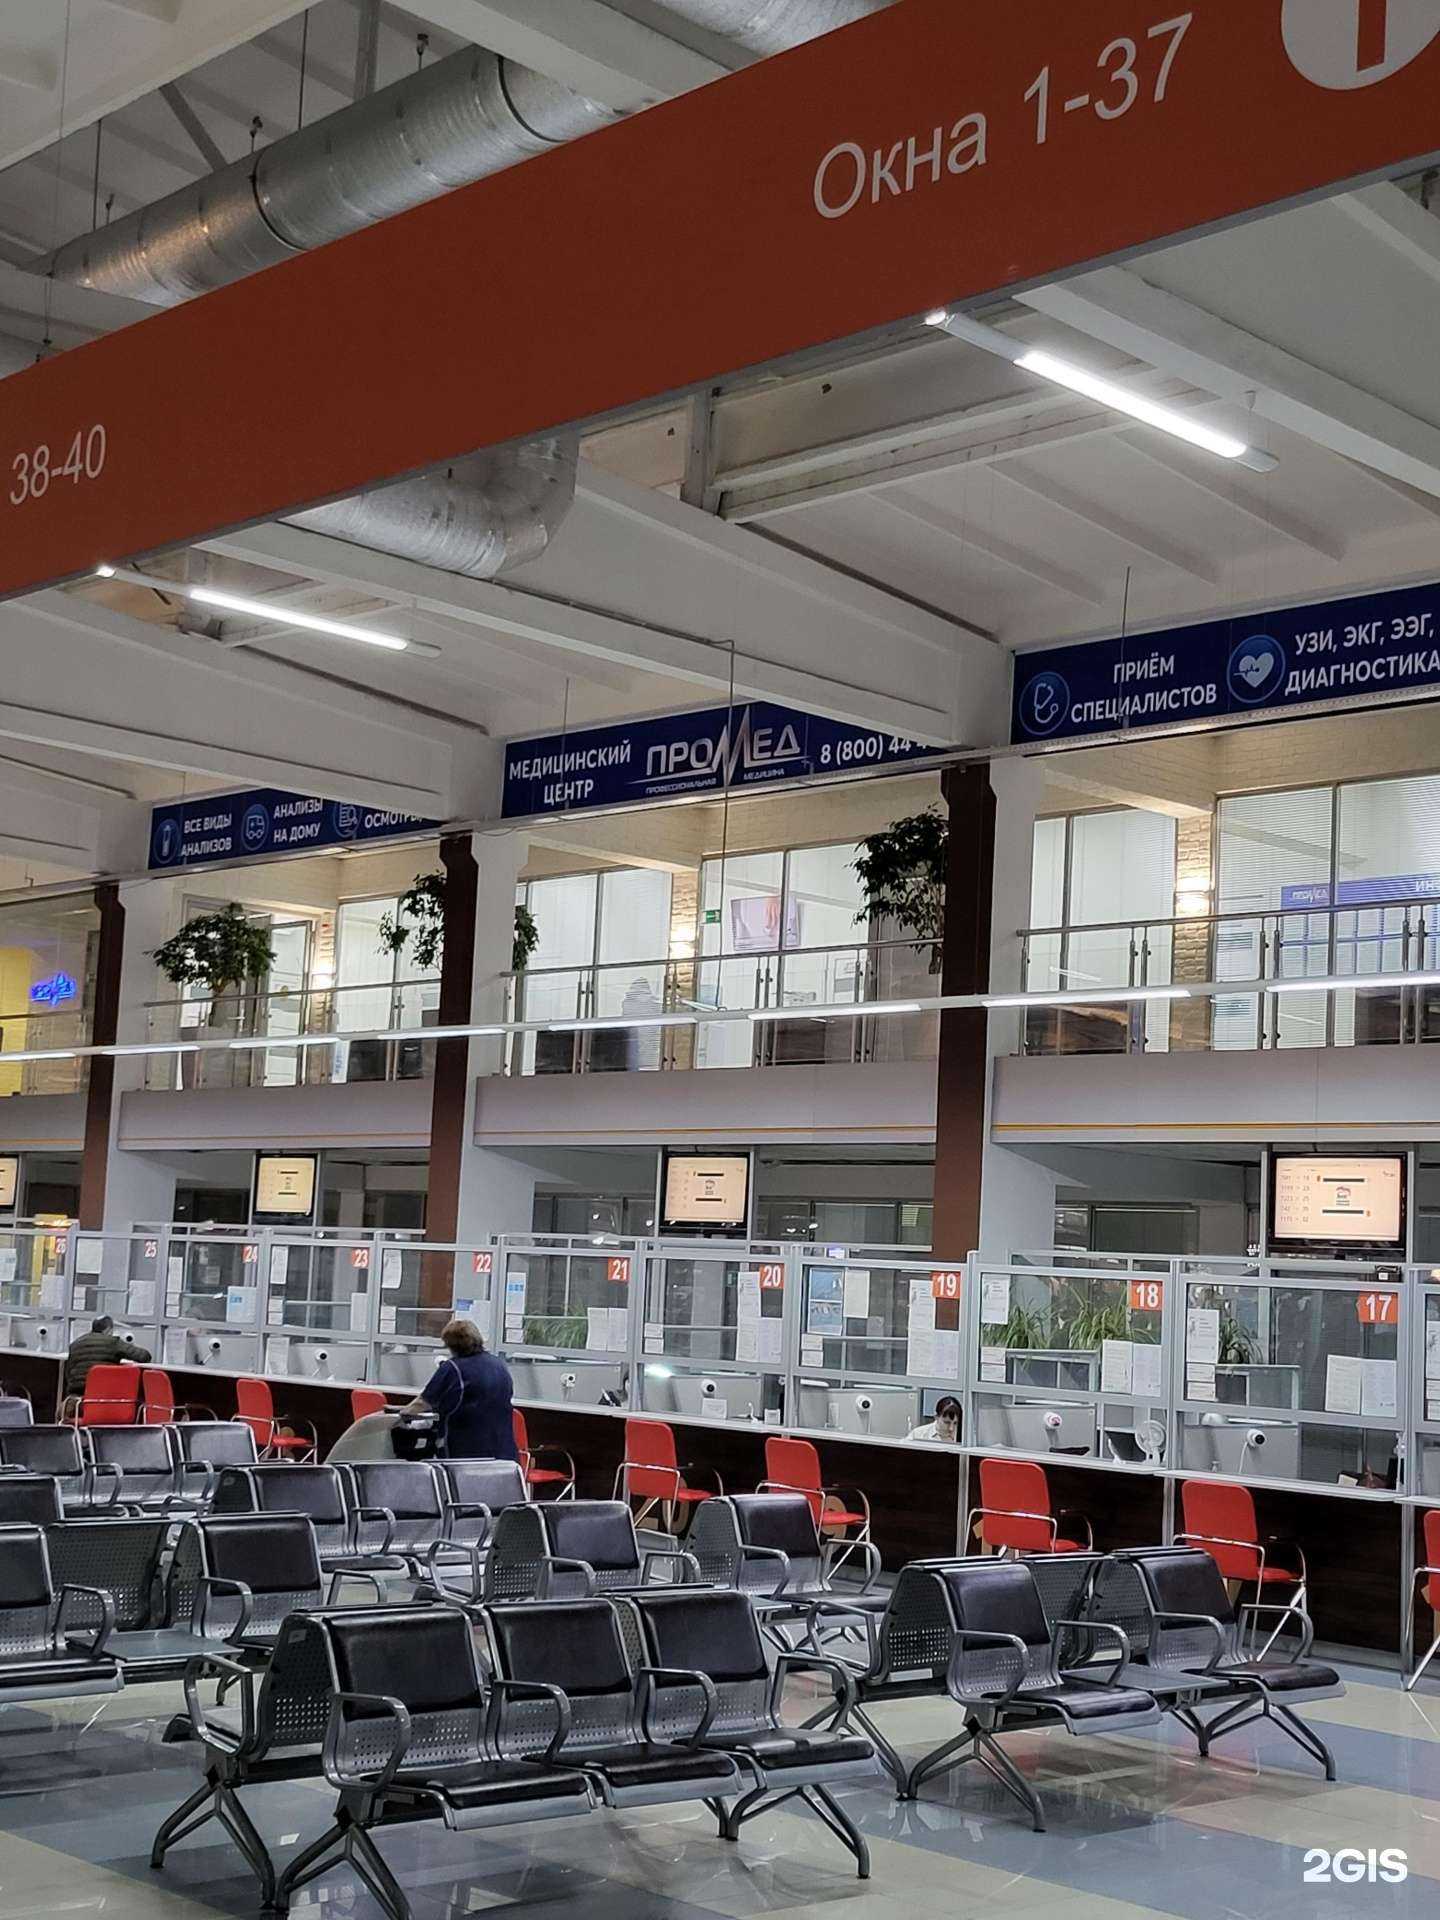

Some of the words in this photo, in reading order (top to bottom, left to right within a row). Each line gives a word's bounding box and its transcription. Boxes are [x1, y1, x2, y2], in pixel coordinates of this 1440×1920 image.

[812, 112, 987, 219] Окна
[1023, 12, 1193, 144] 1-37
[9, 423, 106, 505] 38-40
[1295, 628, 1339, 657] УЗИ,
[1343, 620, 1385, 648] ЭКГ,
[1390, 612, 1436, 641] ЭЭГ,
[1113, 654, 1175, 684] ПРИЁМ
[1285, 650, 1440, 695] ДИАГНОСТИКА
[1071, 683, 1218, 725] СПЕЦИАЛИСТОВ
[646, 705, 801, 786] ПРОМЕД
[820, 743, 831, 764] 8
[836, 735, 883, 766] (800)
[509, 739, 631, 780] МЕДИЦИНСКИЙ
[543, 780, 594, 806] ЦЕНТР
[273, 798, 324, 820] АНАЛИЗЫ
[184, 819, 202, 834] ВСЕ
[203, 813, 232, 831] ВИДЫ
[273, 828, 288, 844] НА
[289, 822, 321, 843] ДОМУ
[181, 837, 233, 857] АНАЛИЗОВ
[145, 1241, 157, 1258] 25
[244, 1246, 258, 1264] 24
[353, 1250, 368, 1268] 23
[475, 1253, 491, 1272] 22
[612, 1259, 629, 1279] 21
[763, 1265, 782, 1287] 20
[937, 1273, 957, 1296] 19
[1136, 1282, 1159, 1308] 18
[1366, 1294, 1392, 1321] 17
